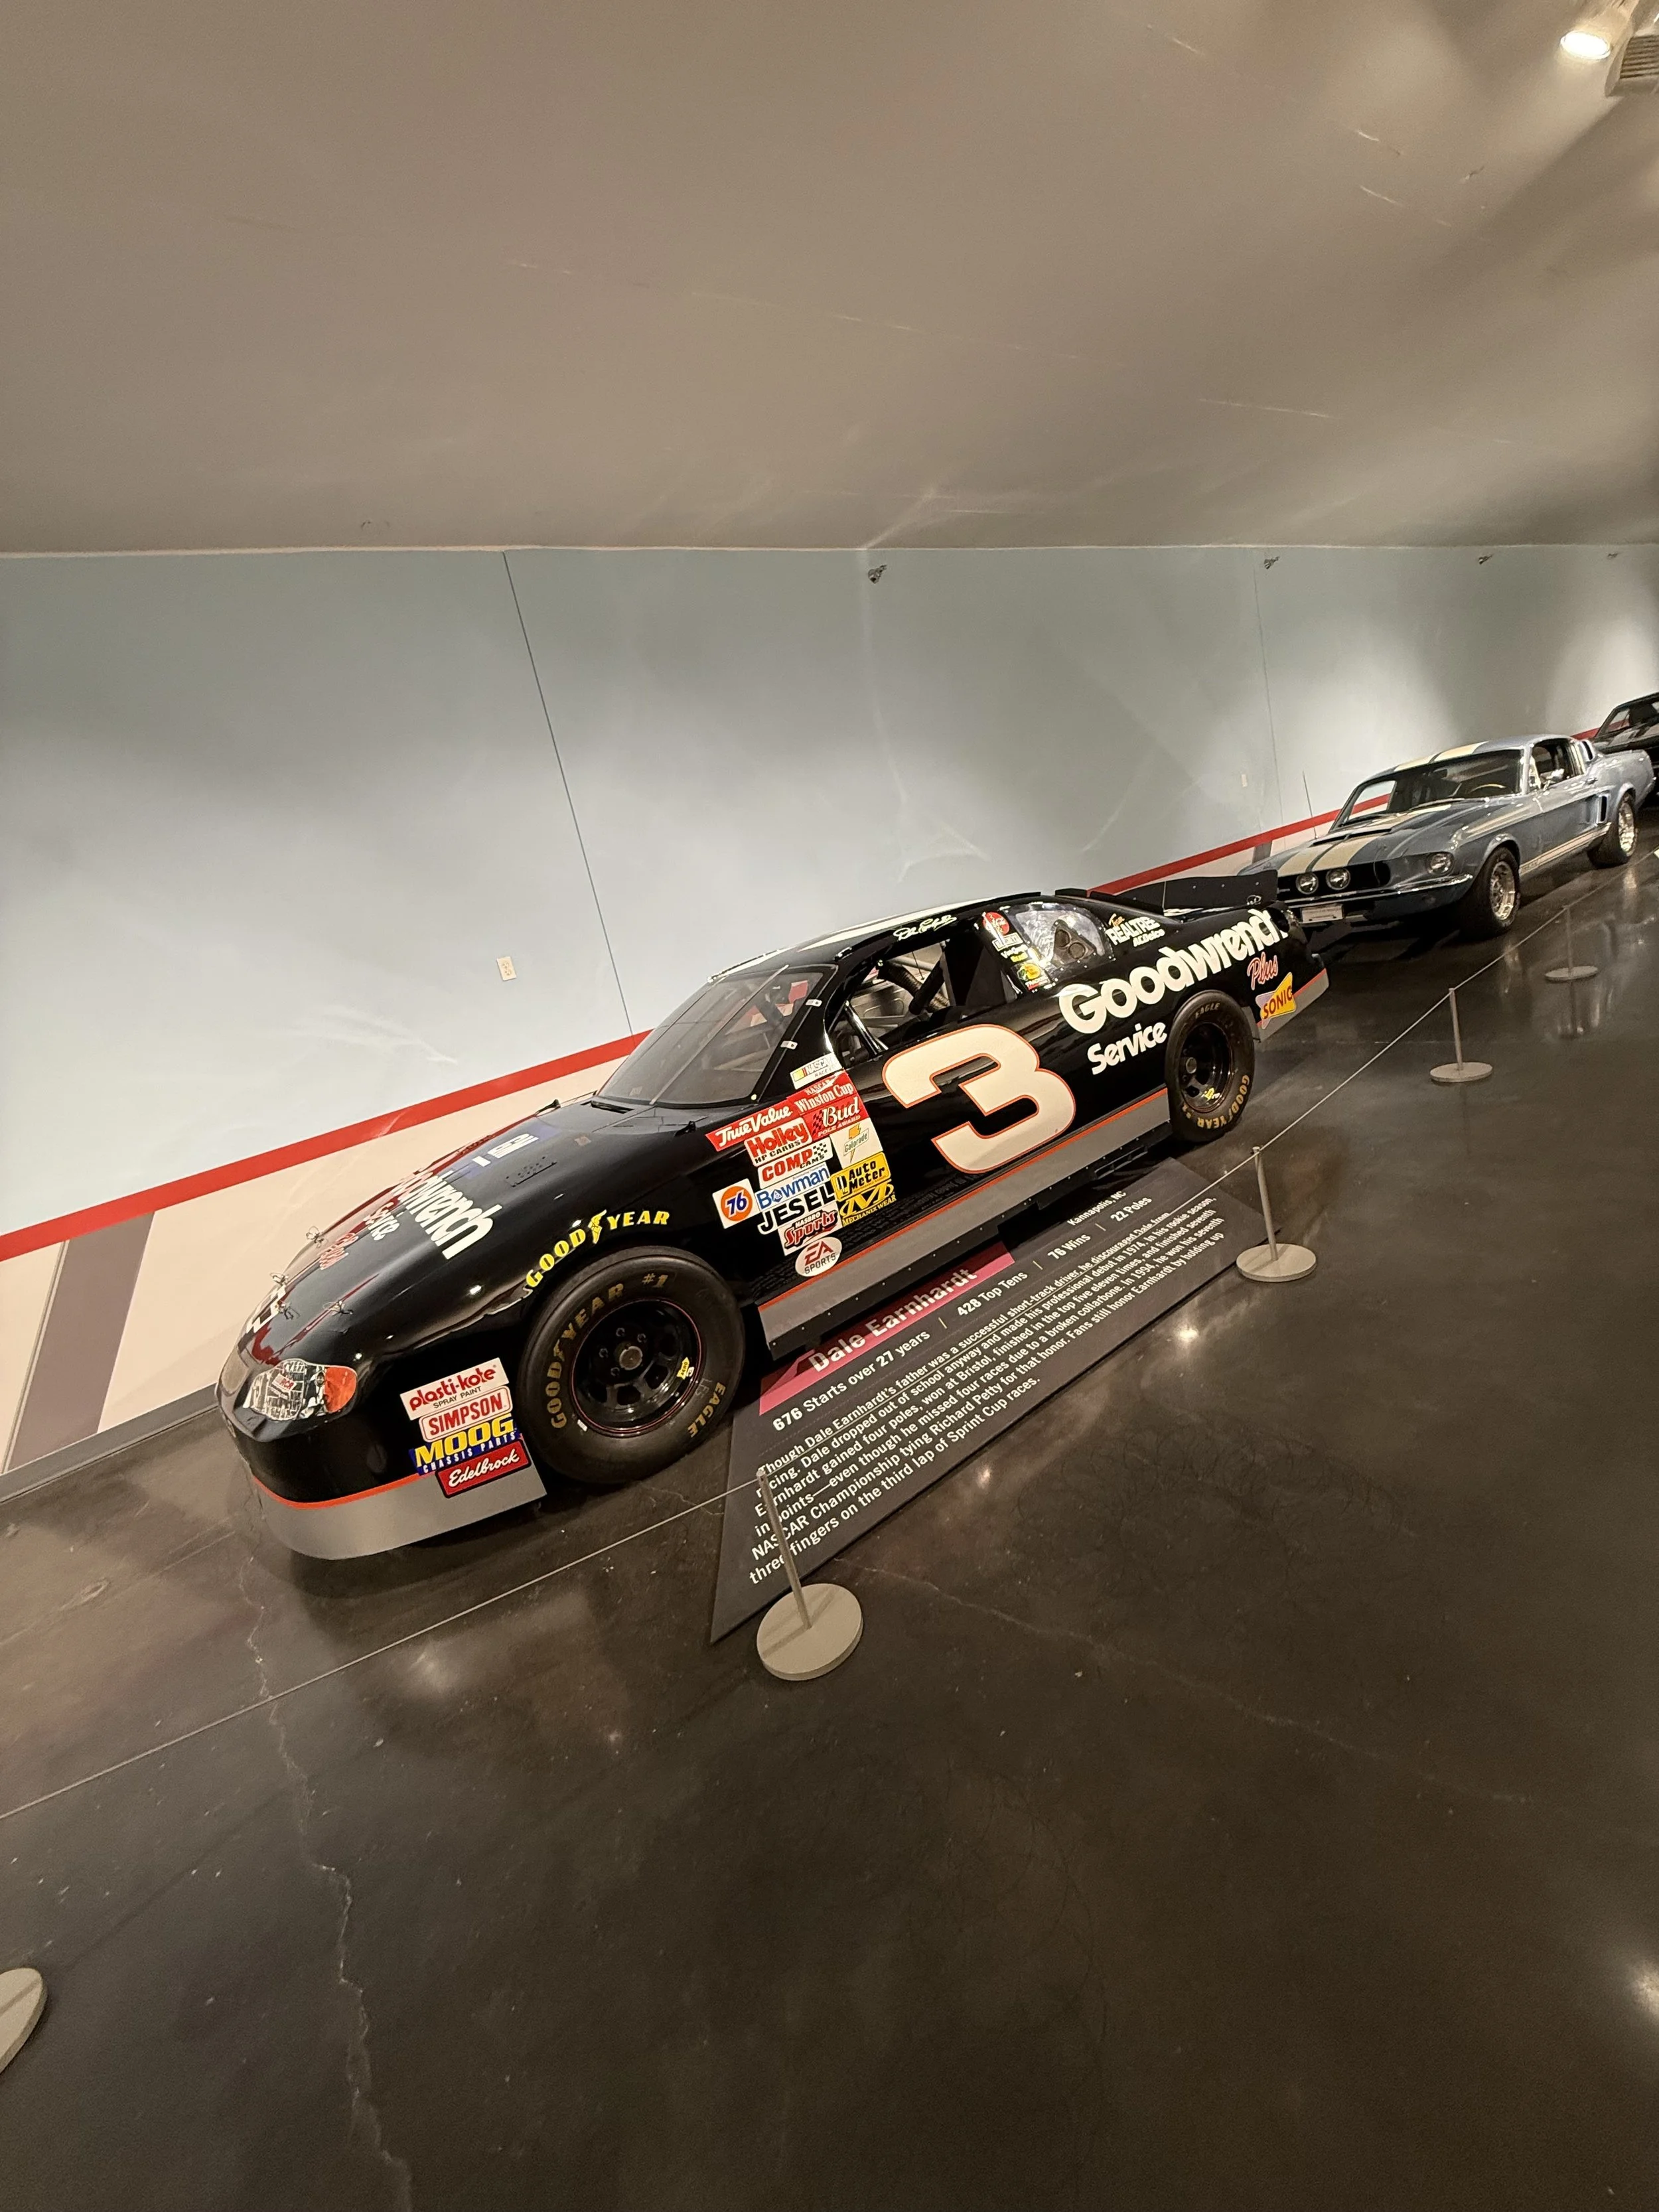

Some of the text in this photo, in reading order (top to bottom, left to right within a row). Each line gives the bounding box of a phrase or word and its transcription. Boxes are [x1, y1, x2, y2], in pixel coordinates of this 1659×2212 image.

[1058, 908, 1289, 1034] Goodwrench
[1247, 951, 1279, 990] Plus
[1195, 1002, 1220, 1019] EAGLE
[1263, 986, 1293, 1019] SONIC
[805, 1055, 837, 1075] NASCA
[1087, 1021, 1168, 1076] Service
[794, 1082, 855, 1112] Winston Cup
[804, 1079, 831, 1095] NASCAR
[882, 1024, 1076, 1174] 3
[1196, 1074, 1250, 1130] GOODYEAR
[818, 1114, 861, 1137] POLE AWARD
[822, 1098, 860, 1127] Bud
[747, 1122, 809, 1157] Holley
[755, 1140, 801, 1163] HP CARBS
[762, 1147, 814, 1183] COMP
[799, 1153, 826, 1169] CAMS
[849, 1160, 877, 1181] Auto
[849, 1166, 886, 1193] Meter
[726, 1197, 749, 1217] 76
[757, 1166, 830, 1210] Bowman
[759, 1185, 835, 1232] JESEL
[795, 1211, 821, 1228] HASBRO
[842, 1194, 897, 1226] MECHANIX WEAR
[1067, 1191, 1127, 1226] Kannapolis, NC
[1110, 1197, 1153, 1222] 22 Poles
[784, 1209, 838, 1248] Sports
[1047, 1234, 1092, 1260] 76 Wins
[526, 1209, 670, 1288] GOODYEAR
[804, 1240, 834, 1265] EA
[804, 1254, 836, 1274] SPORTS
[957, 1272, 1028, 1317] 428 Top Tens
[807, 1268, 977, 1372] Dale Earnhardt
[546, 1272, 668, 1430] GOODYEAR #1
[756, 1467, 801, 1498] rcing.
[800, 1446, 831, 1468] Dale
[831, 1414, 878, 1449] dropped
[879, 1401, 899, 1418] out
[897, 1391, 911, 1404] of
[910, 1370, 945, 1396] school
[944, 1347, 982, 1373] anyway
[981, 1335, 1001, 1349] and
[1000, 1317, 1028, 1337] made
[1025, 1307, 1043, 1319] his
[1042, 1274, 1094, 1311] professional
[1092, 1260, 1118, 1277] debut
[1113, 1254, 1126, 1262] in
[1123, 1241, 1149, 1256] 1974.
[1152, 1228, 1169, 1237] his
[1166, 1213, 1190, 1229] rookie
[1187, 1197, 1217, 1215] season,
[758, 1212, 1170, 1473] Though Dale Earnhardt's father was a successful short-track driver, he discouraged Dale from
[755, 1209, 1216, 1517] Ernhardt gained four poles, won at Bristol, finished in the top five eleven times, and finished seventh
[755, 1522, 770, 1537] in
[859, 1434, 902, 1466] though
[900, 1423, 918, 1438] he
[918, 1394, 958, 1426] missed
[956, 1380, 981, 1399] four
[980, 1361, 1010, 1383] races
[1008, 1349, 1029, 1364] due
[1026, 1341, 1041, 1351] to
[1045, 1313, 1080, 1337] broken
[1077, 1286, 1126, 1316] collarbone.
[1120, 1277, 1135, 1286] In
[1131, 1262, 1159, 1279] 1994,
[1153, 1254, 1169, 1264] he
[1165, 1244, 1185, 1256] won
[1179, 1236, 1197, 1246] his
[1194, 1217, 1225, 1238] seventh
[772, 1331, 931, 1432] 676 Starts over 27 years
[409, 1367, 496, 1411] plasti-kote
[433, 1386, 482, 1409] SPRAY PAINT
[751, 1232, 1224, 1560] NASCAR Championship tying Richard Petty for that honor. Fans still honor Earnhardt by holding up
[428, 1392, 504, 1436] SIMPSON
[687, 1381, 727, 1438] EAGLE
[415, 1416, 515, 1468] MOOG
[423, 1431, 516, 1474] CHASSIS PARTS
[448, 1448, 520, 1487] Edelbrock
[790, 1517, 839, 1556] fingers
[840, 1503, 859, 1520] on
[858, 1486, 882, 1507] the
[881, 1463, 914, 1491] third
[912, 1450, 935, 1469] lap
[934, 1438, 950, 1452] of
[947, 1414, 985, 1442] Sprint
[982, 1398, 1008, 1417] Cup
[1006, 1377, 1041, 1402] races.
